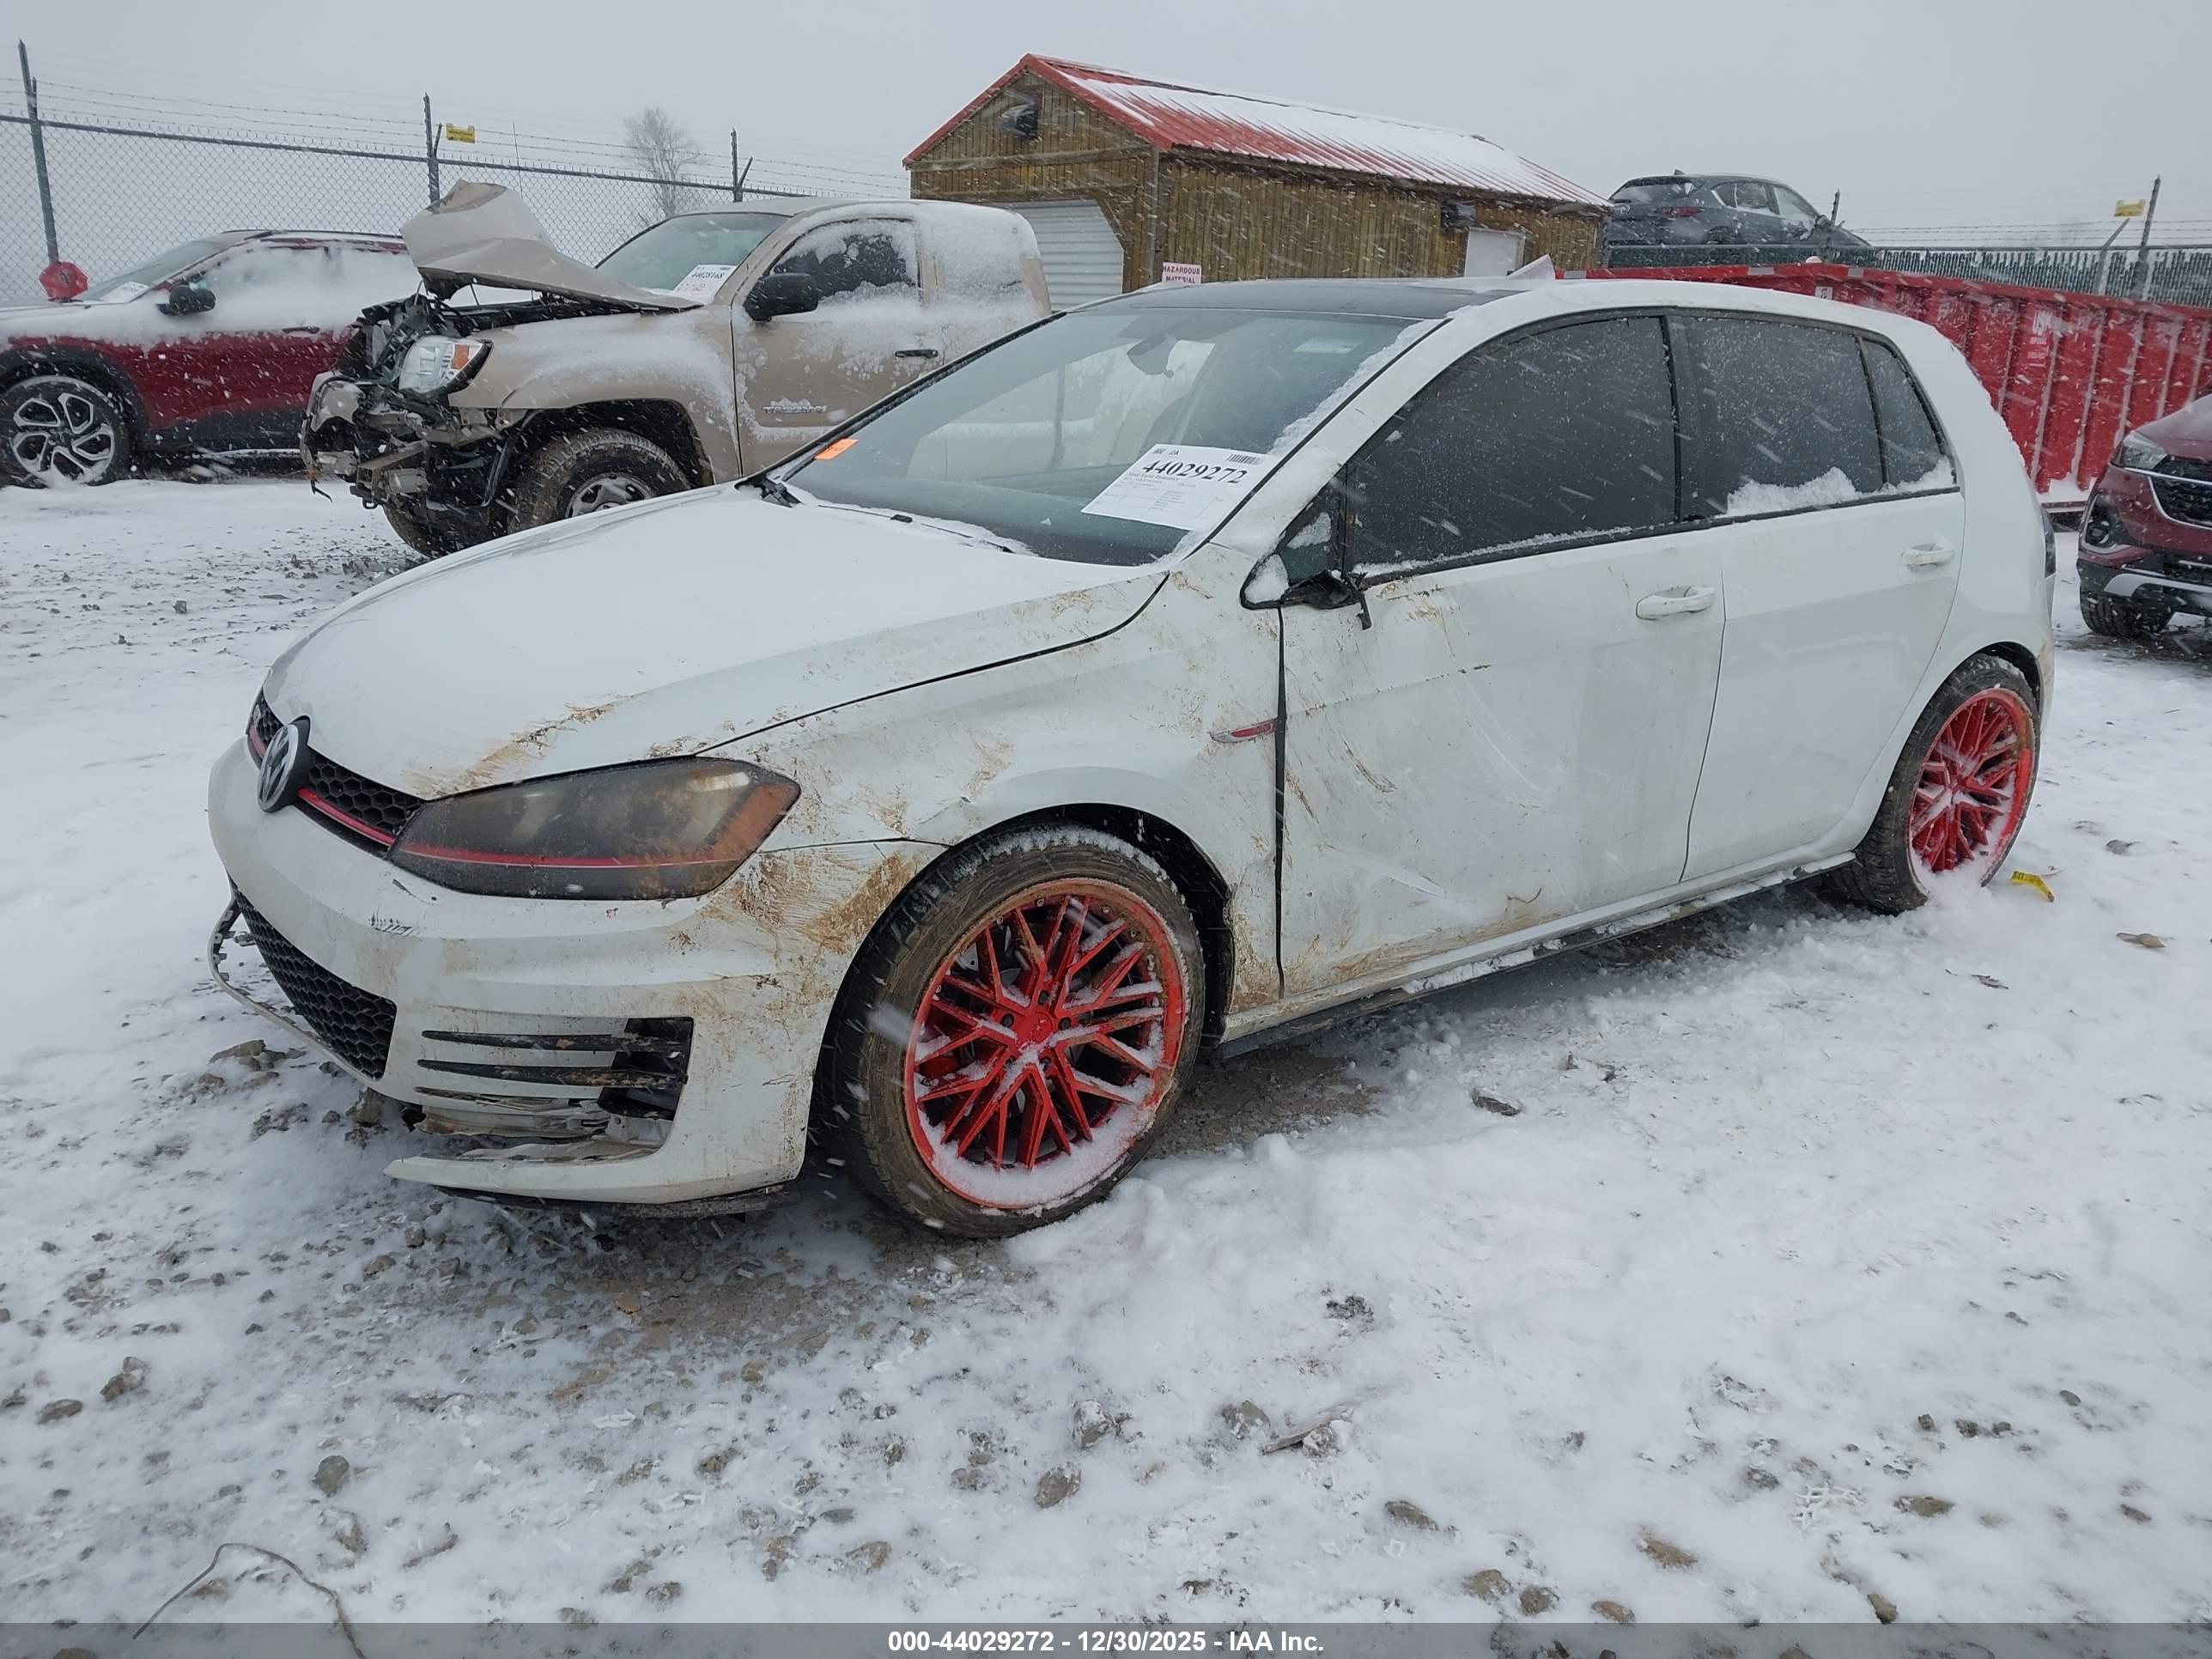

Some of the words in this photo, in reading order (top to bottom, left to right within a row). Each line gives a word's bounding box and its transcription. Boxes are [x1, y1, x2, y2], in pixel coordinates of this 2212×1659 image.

[1163, 266, 1200, 275] HAZARDOUS
[1166, 276, 1196, 284] MATERIAL
[1142, 460, 1248, 483] 44029272
